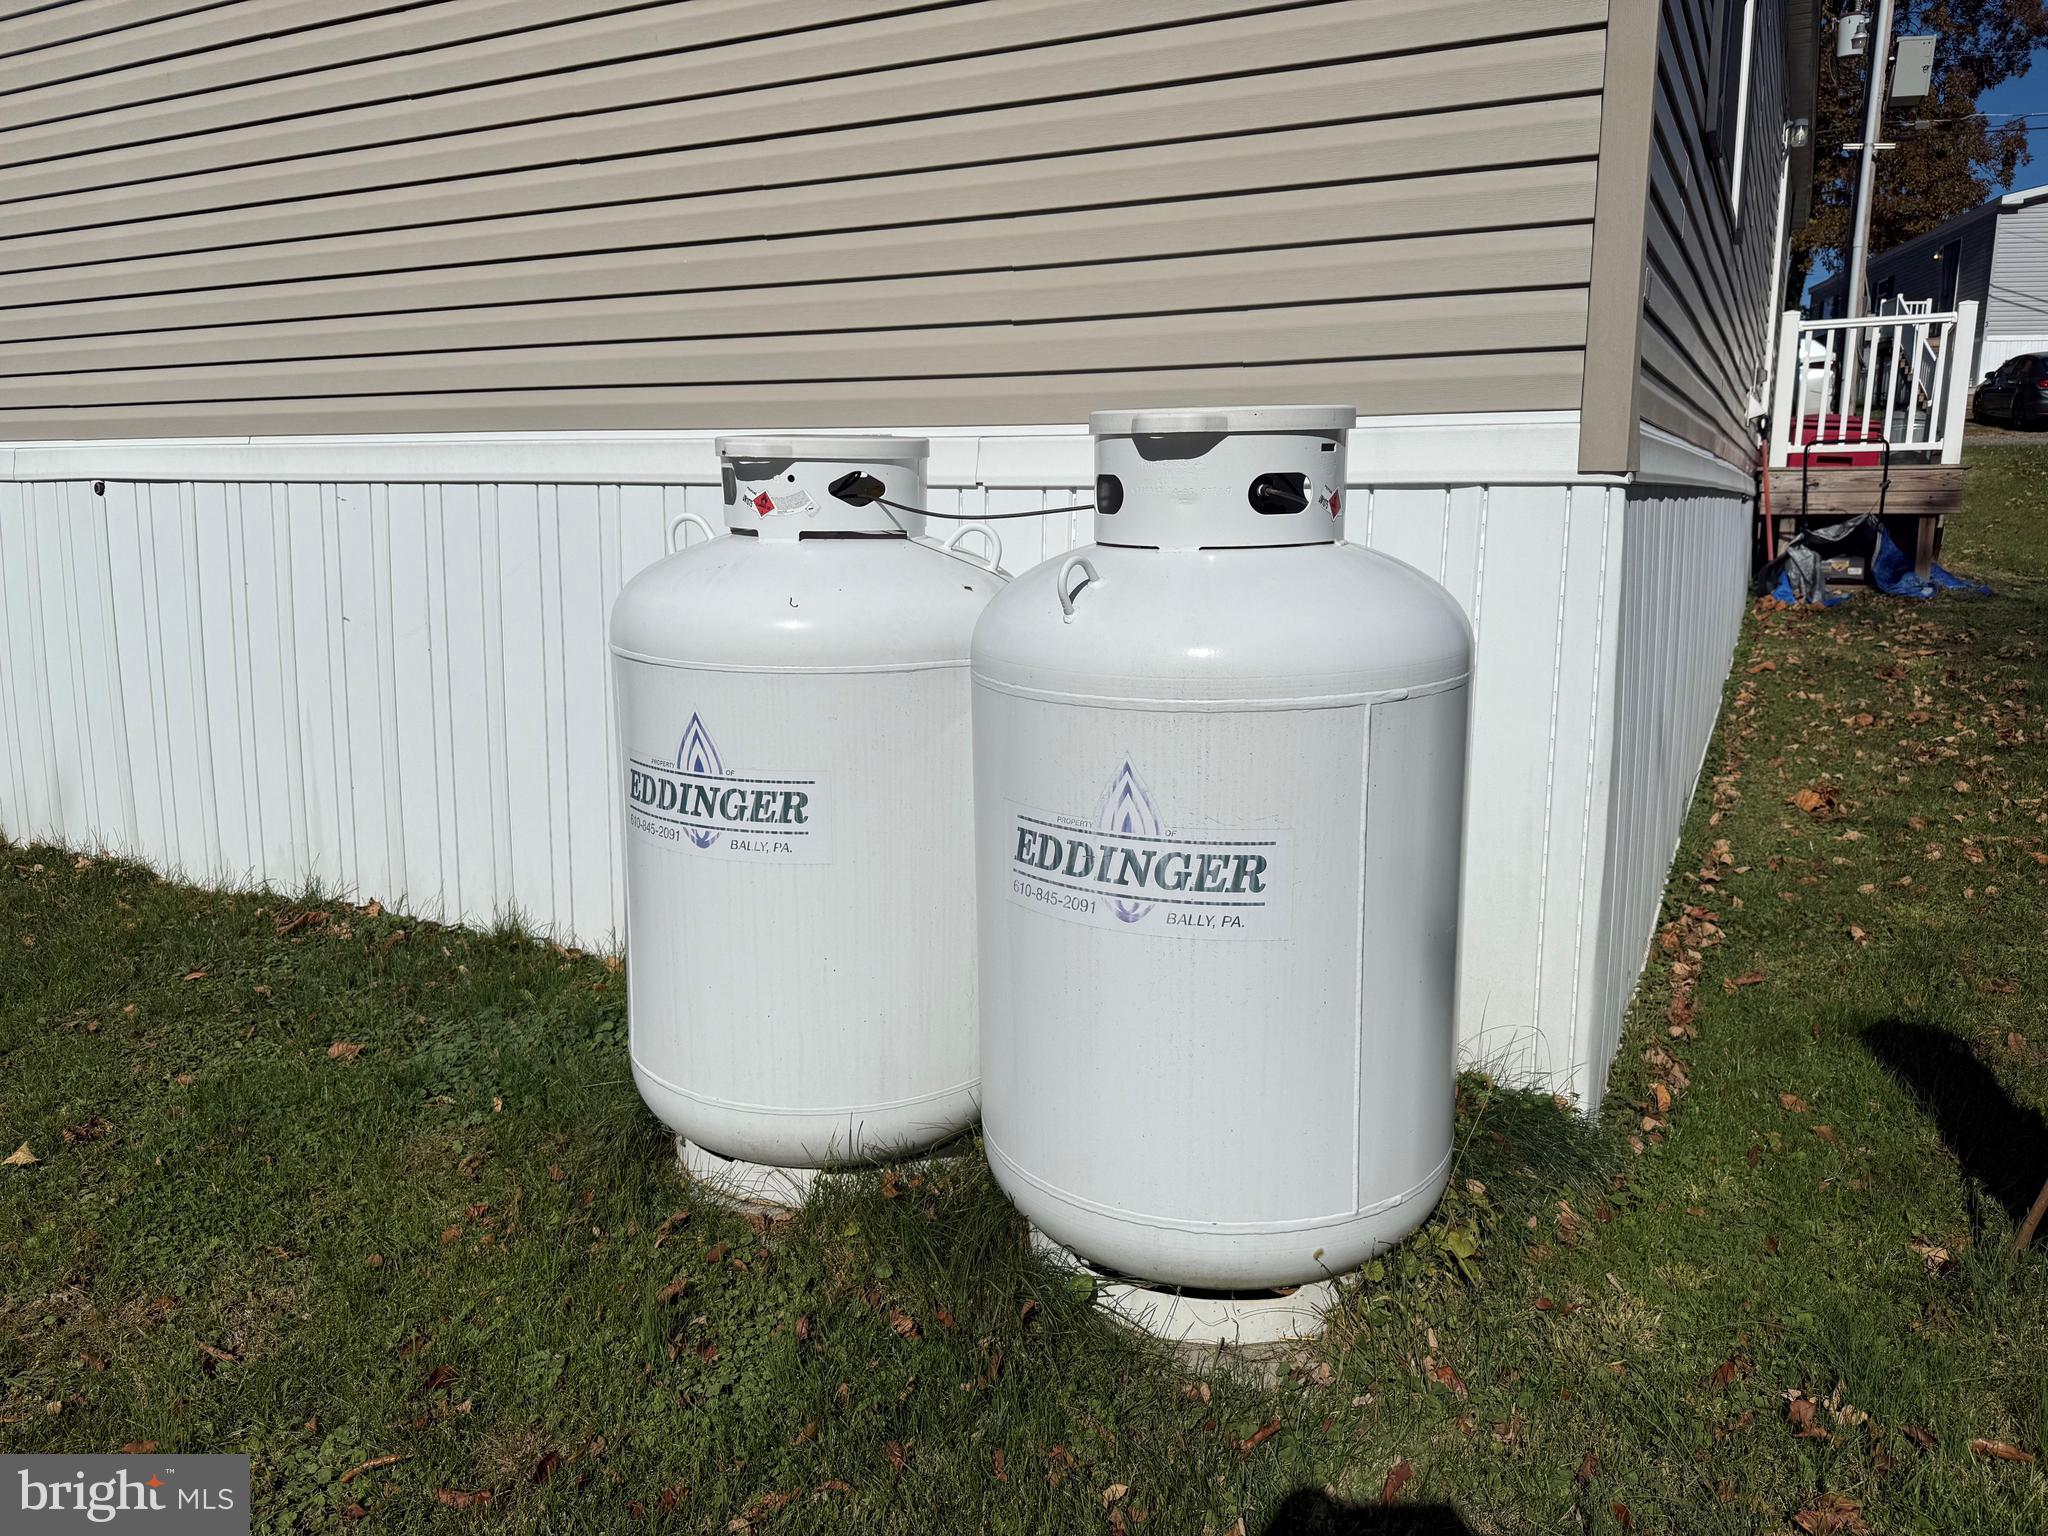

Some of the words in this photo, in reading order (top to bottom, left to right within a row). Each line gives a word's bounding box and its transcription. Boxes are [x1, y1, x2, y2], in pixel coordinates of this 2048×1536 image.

[651, 758, 675, 769] PROPERTY
[630, 768, 809, 824] EDDINGER
[630, 814, 680, 842] 610-845-2091
[1056, 815, 1094, 828] PROPERTY
[1164, 829, 1177, 837] OF
[730, 839, 769, 854] BALLY,
[773, 841, 793, 853] PA.
[1014, 826, 1268, 894] EDDINGER
[1012, 879, 1097, 914] 610-845-2091
[1166, 912, 1216, 929] BALLY,
[1220, 915, 1245, 928] PA.
